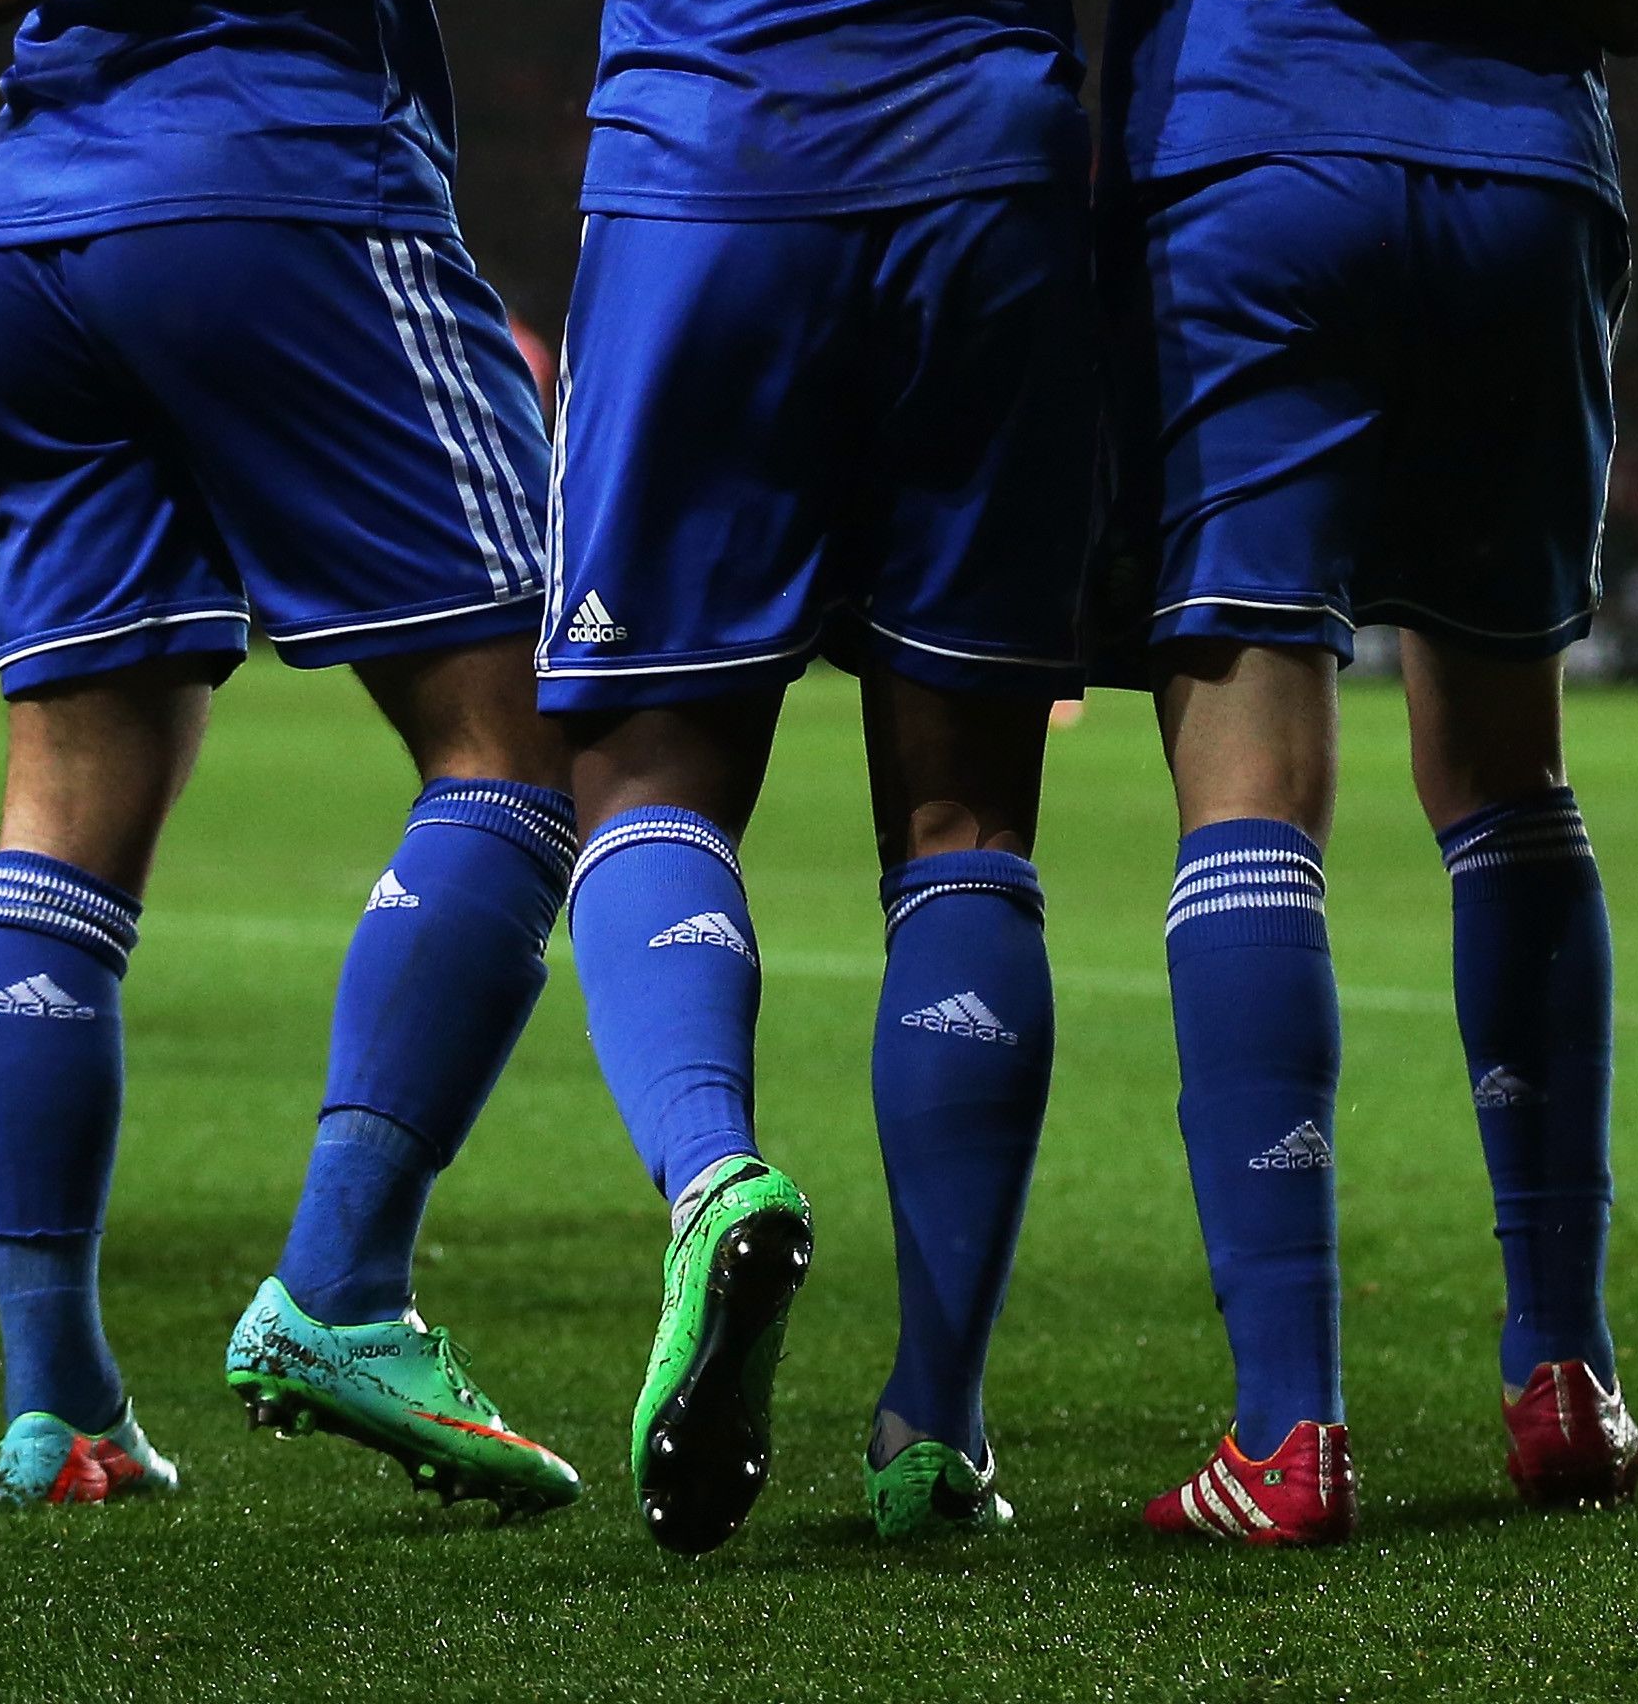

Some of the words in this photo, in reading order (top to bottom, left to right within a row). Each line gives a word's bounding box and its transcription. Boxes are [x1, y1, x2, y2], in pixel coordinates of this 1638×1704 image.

[567, 623, 628, 643] adidas
[648, 931, 757, 967] adidas
[901, 1014, 1018, 1046] adidas
